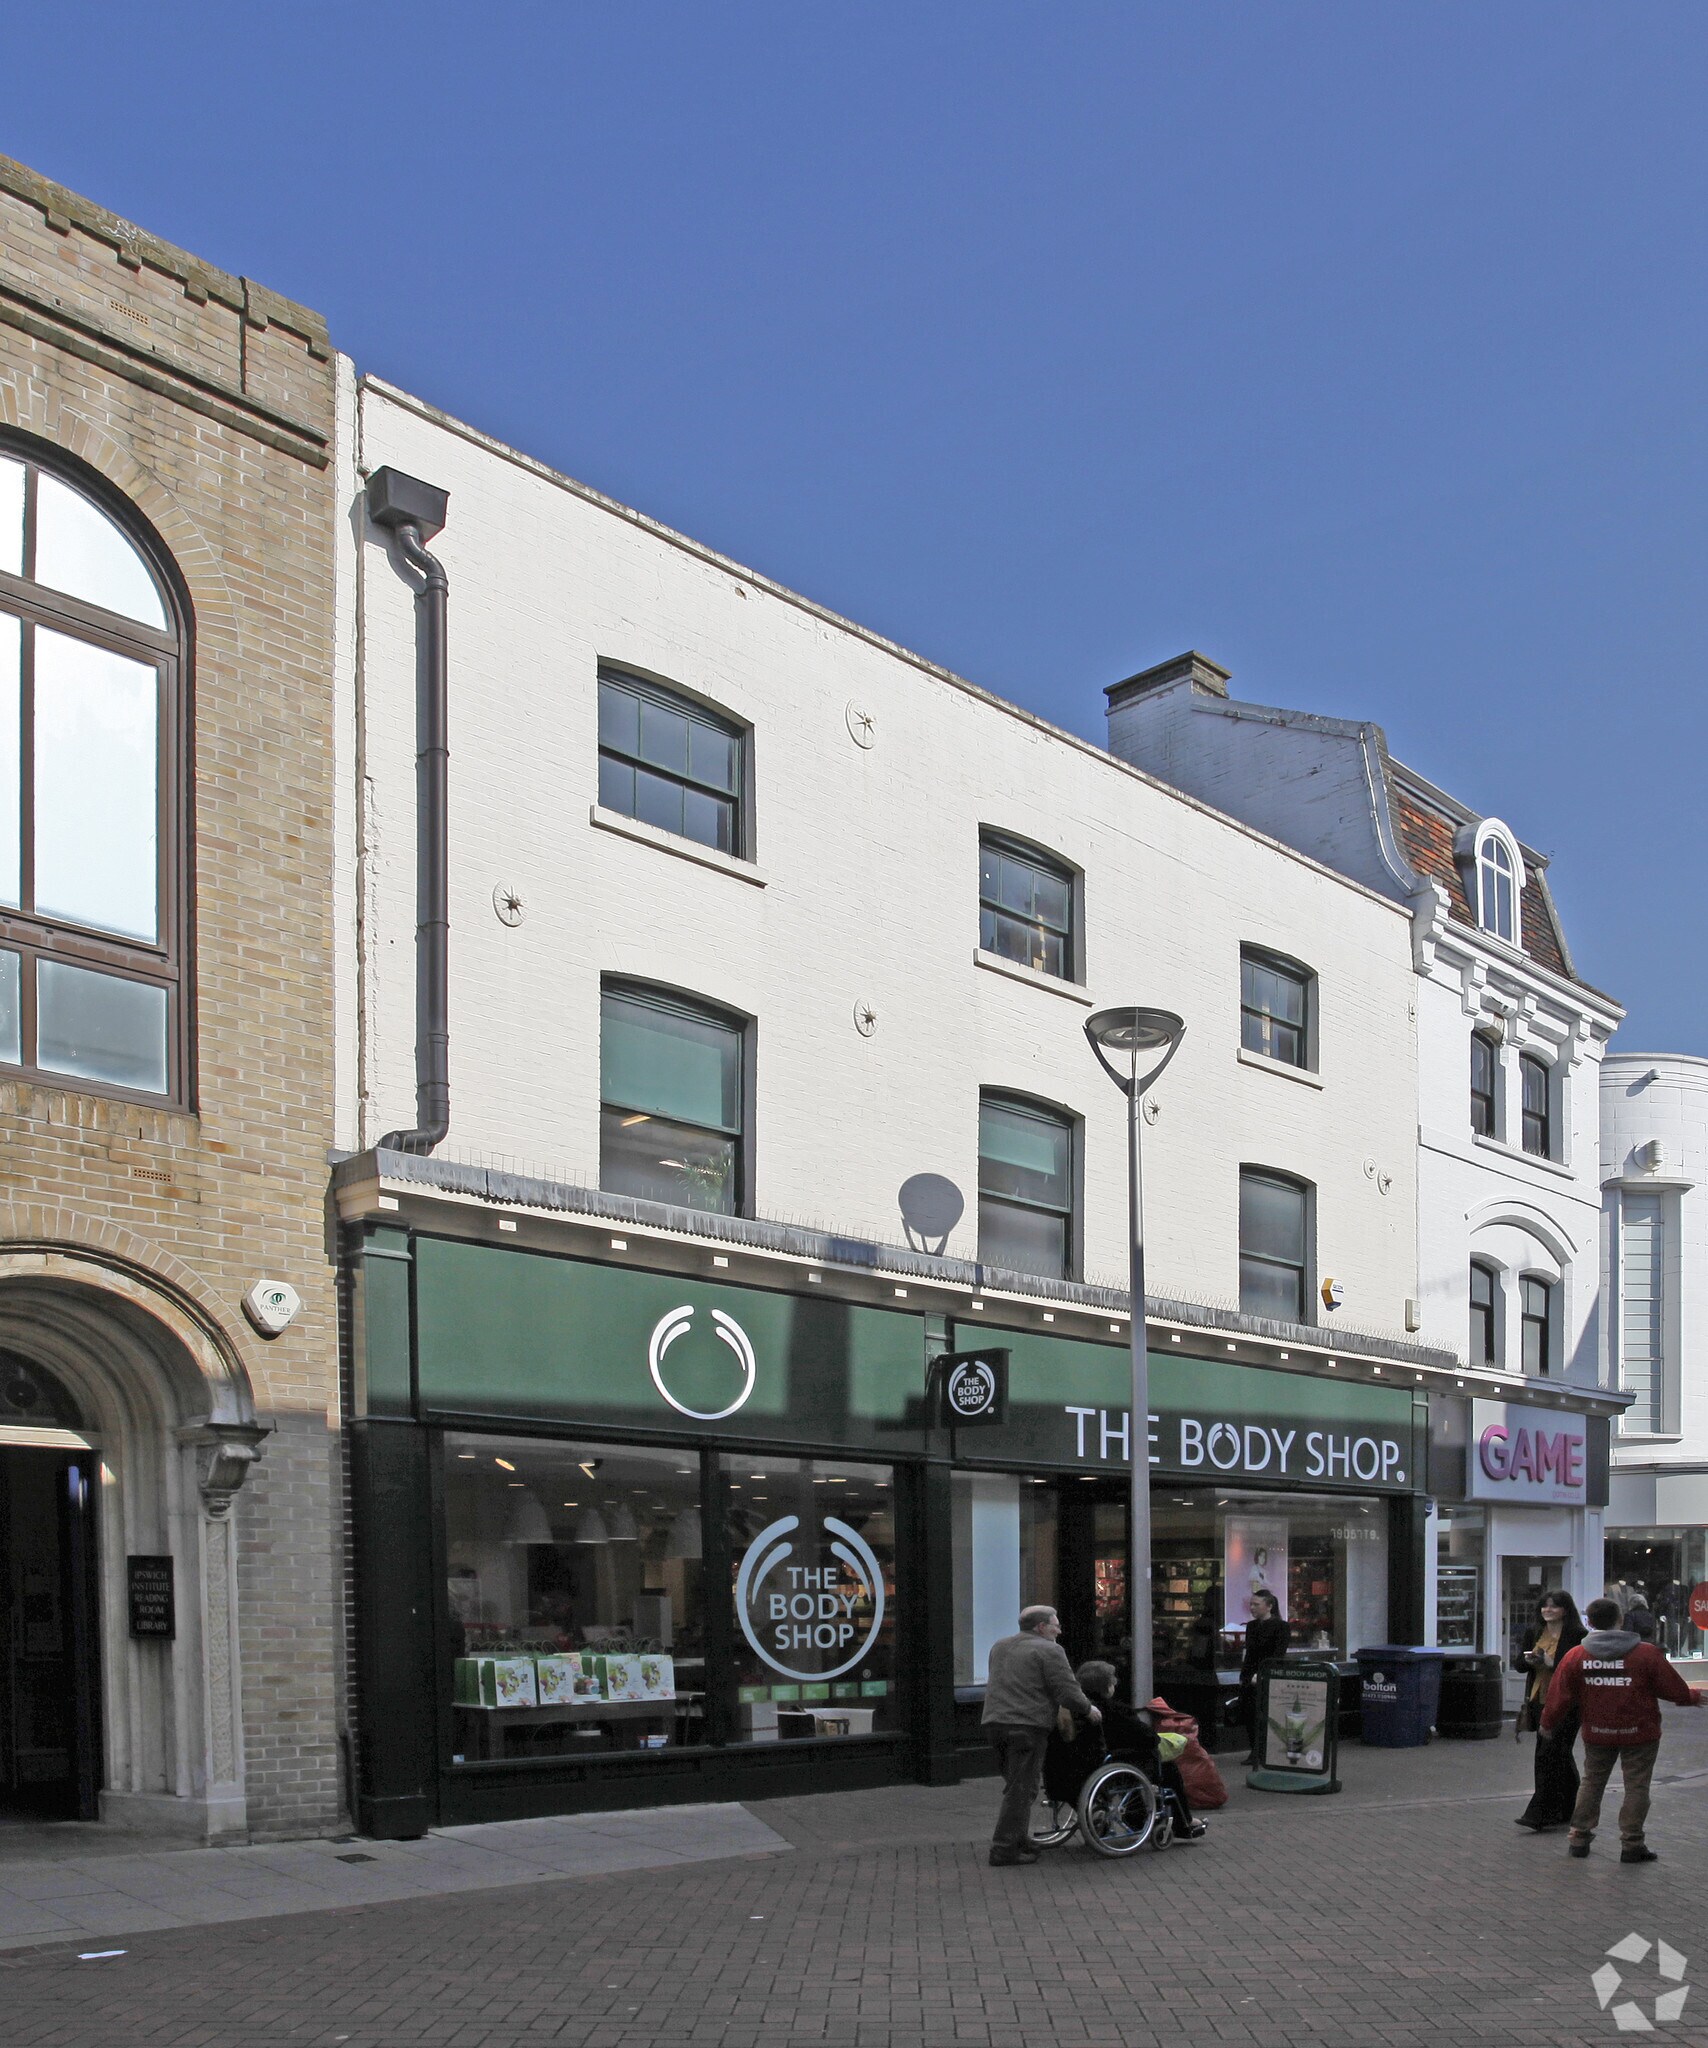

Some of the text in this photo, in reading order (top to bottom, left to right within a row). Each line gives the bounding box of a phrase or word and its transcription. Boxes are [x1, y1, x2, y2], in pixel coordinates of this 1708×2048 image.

[260, 1304, 291, 1313] PANTHER
[963, 1377, 980, 1386] THE
[957, 1385, 986, 1397] BODY
[959, 1395, 985, 1406] SHOP
[1180, 1418, 1296, 1473] BODY
[1479, 1423, 1584, 1487] GAME
[134, 1571, 168, 1580] IPSWICH
[787, 1566, 838, 1590] THE
[131, 1582, 171, 1592] INSTITUTE
[134, 1594, 169, 1603] READING
[139, 1605, 164, 1615] ROOM
[769, 1593, 858, 1620] BODY
[1694, 1600, 1708, 1612] SA
[136, 1621, 168, 1631] LIBRARY
[775, 1623, 854, 1650] SHOP
[1582, 1660, 1625, 1669] HOME
[1270, 1668, 1284, 1677] THE
[1285, 1669, 1307, 1678] BODY
[1363, 1680, 1397, 1692] bolton
[1584, 1677, 1633, 1687] HOME?
